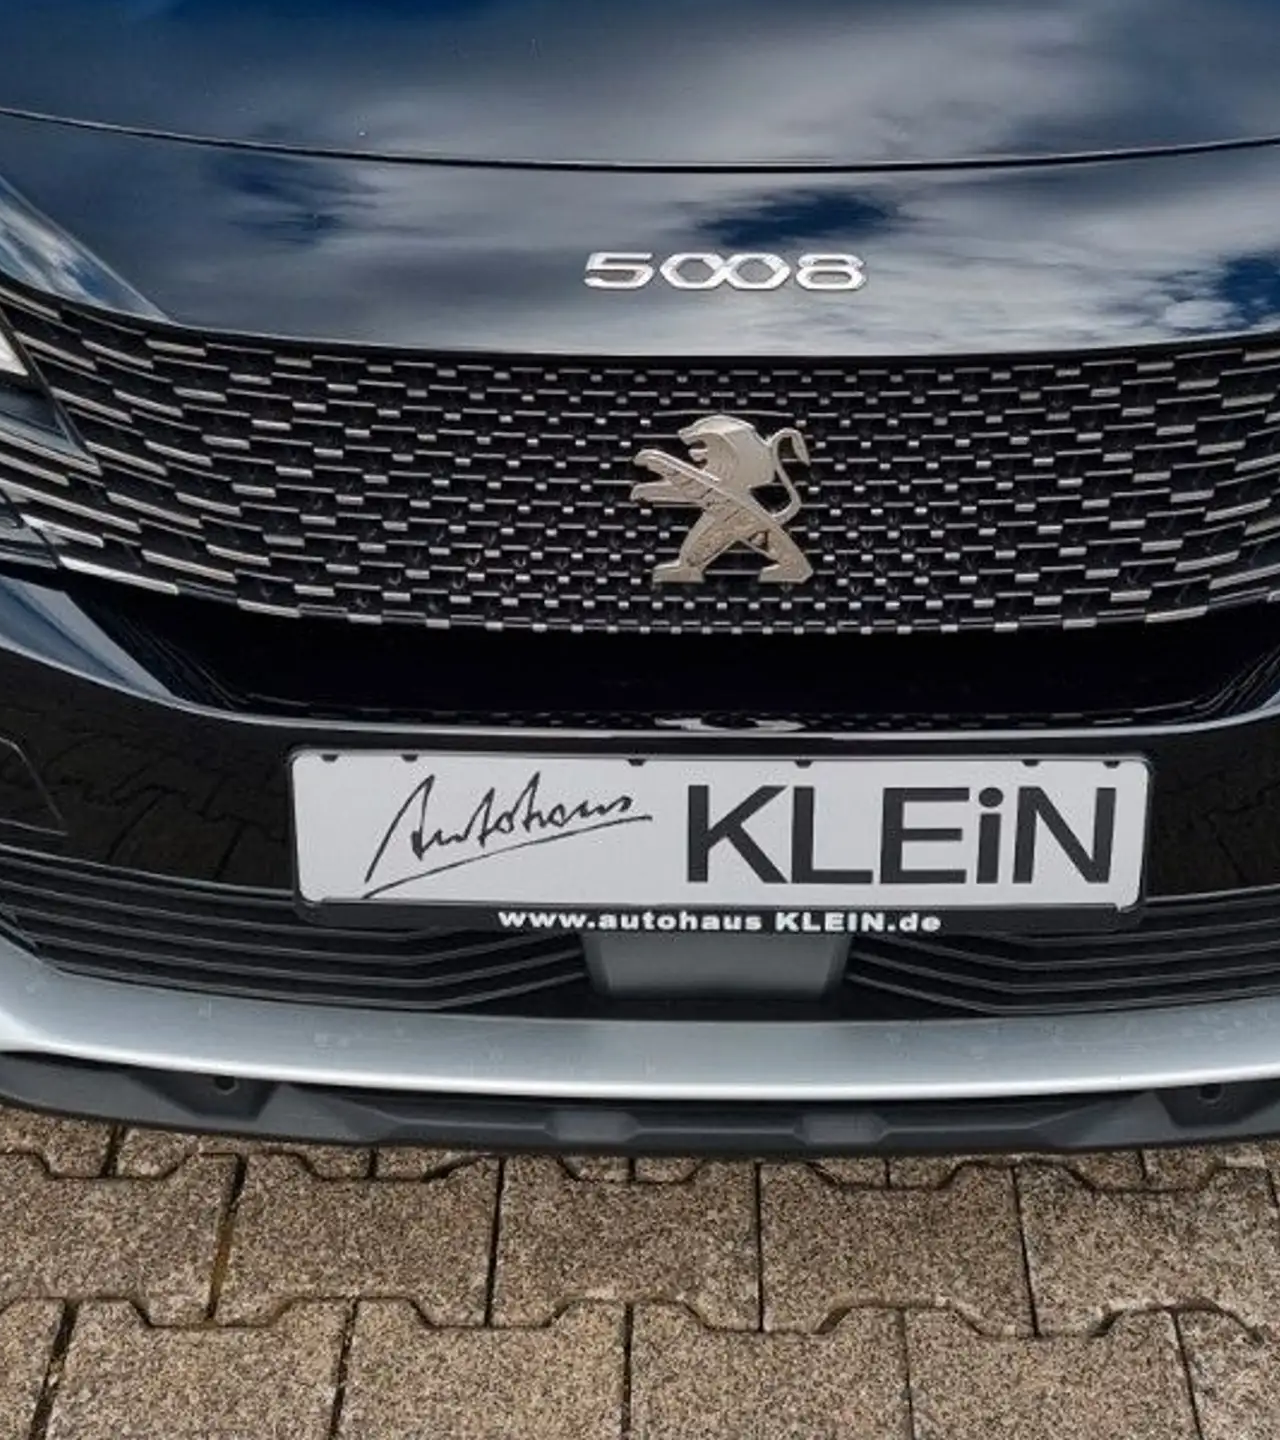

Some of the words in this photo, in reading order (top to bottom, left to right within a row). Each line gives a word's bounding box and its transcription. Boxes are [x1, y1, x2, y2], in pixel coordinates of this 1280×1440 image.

[583, 252, 867, 290] 5008
[364, 771, 634, 884] Autohaus
[498, 911, 762, 930] www.autohaus
[775, 911, 941, 932] KLEIN.de
